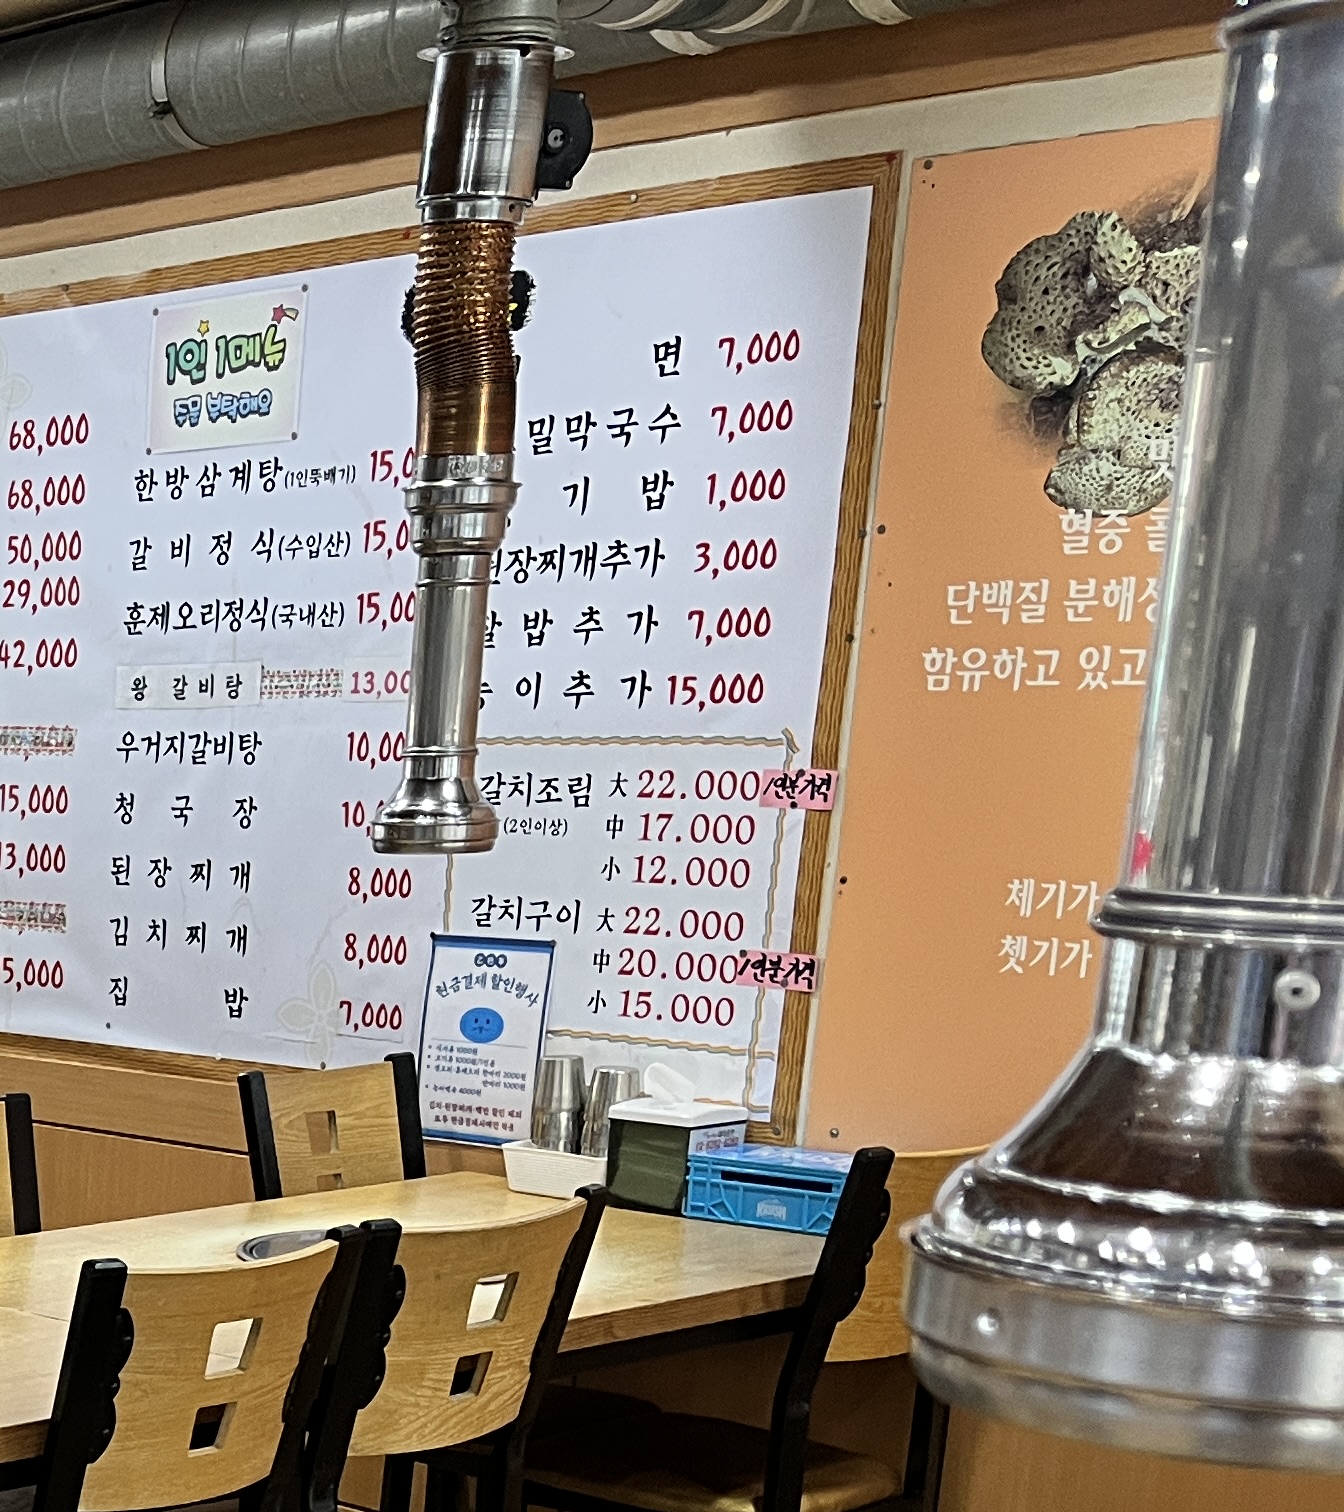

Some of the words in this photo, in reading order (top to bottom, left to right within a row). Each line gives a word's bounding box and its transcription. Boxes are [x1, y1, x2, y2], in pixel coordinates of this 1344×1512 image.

[166, 335, 207, 385] 1인
[216, 323, 286, 376] 1메뉴
[719, 329, 800, 375] 7,000
[174, 393, 202, 427] 주문
[206, 387, 273, 425] 부탁해요
[528, 403, 681, 455] 밀막국수
[711, 399, 793, 443] 7,000
[9, 413, 89, 456] 68,000
[8, 474, 85, 516] 68,000
[563, 470, 674, 516] 기밥
[707, 468, 785, 512] 1,000
[8, 530, 81, 571] 50,000
[1059, 507, 1131, 554] 혈중
[694, 538, 777, 580] 3,000
[3, 576, 80, 615] 29,000
[356, 592, 414, 627] 15,00
[946, 579, 1049, 624] 단백질
[688, 607, 771, 647] 7,000
[350, 669, 410, 699] 13,00
[922, 646, 1060, 692] 함유하고
[668, 673, 763, 712] 15,000
[116, 731, 262, 765] 우거지갈비탕
[346, 731, 406, 770] 10,00
[0, 784, 68, 820] 15,000
[478, 771, 594, 809] 갈치조림
[608, 773, 628, 797] 大
[637, 770, 760, 801] 22.000
[504, 817, 567, 837] (2인이상)
[606, 814, 623, 839] 中
[638, 813, 755, 845] 17.000
[348, 867, 411, 904] 8,000
[601, 856, 620, 881] 小
[632, 856, 750, 888] 12.000
[471, 894, 580, 934] 갈치구이
[596, 908, 615, 932] 大
[623, 907, 743, 941] 22.000
[1004, 877, 1100, 919] 체기가
[344, 933, 406, 969] 8,000
[593, 949, 610, 973] 中
[617, 949, 738, 984] 20.000
[998, 935, 1093, 979] 쳇기가
[339, 1000, 403, 1036] 7,000
[587, 990, 606, 1014] 小
[618, 990, 734, 1026] 15.000
